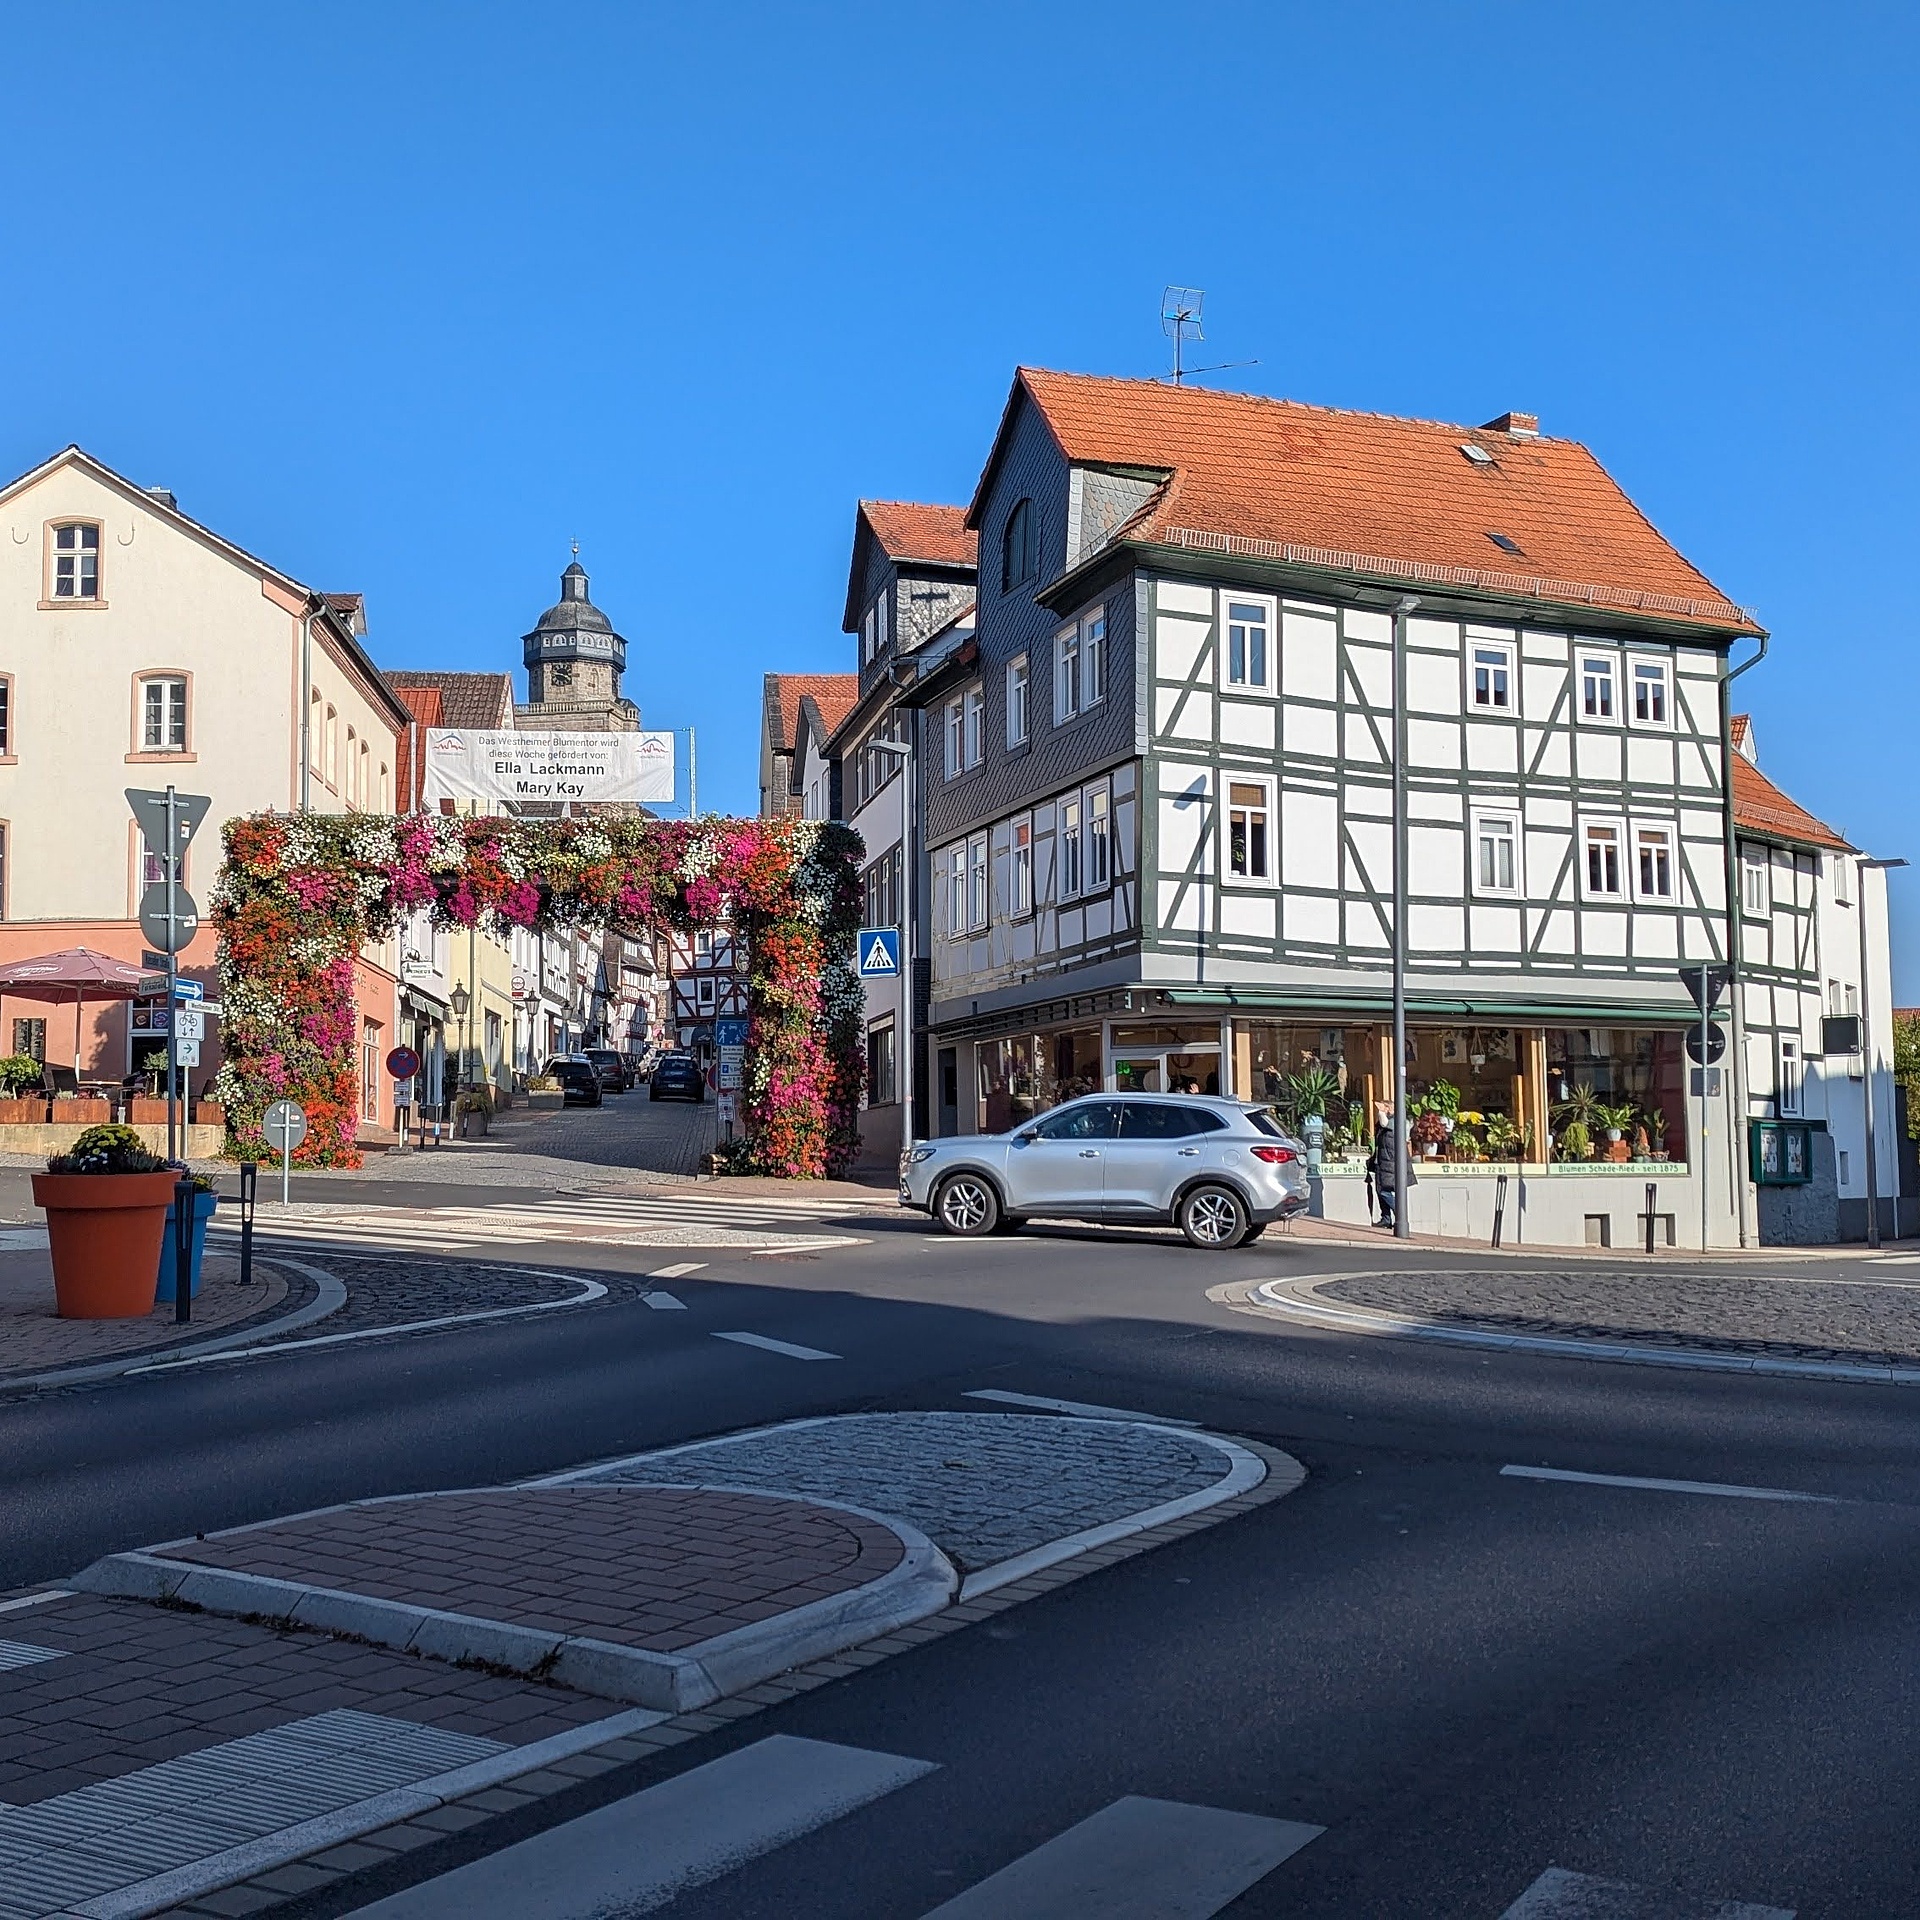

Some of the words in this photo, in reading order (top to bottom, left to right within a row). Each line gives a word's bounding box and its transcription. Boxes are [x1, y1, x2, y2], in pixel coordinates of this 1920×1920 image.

[478, 736, 496, 745] Das
[498, 737, 551, 747] Westheimer
[553, 737, 598, 747] Blumentor
[600, 738, 619, 747] wird
[489, 749, 513, 758] diese
[515, 750, 545, 759] Woche
[547, 750, 588, 761] gefördert
[590, 752, 609, 760] von:
[495, 761, 521, 774] Ella
[530, 762, 605, 775] Lackmann
[516, 781, 552, 796] Mary
[556, 781, 585, 797] Kay
[1558, 1165, 1587, 1173] Blumen
[1588, 1164, 1635, 1173] Schade-Ried
[1643, 1165, 1657, 1173] seit
[1660, 1164, 1679, 1173] 1875
